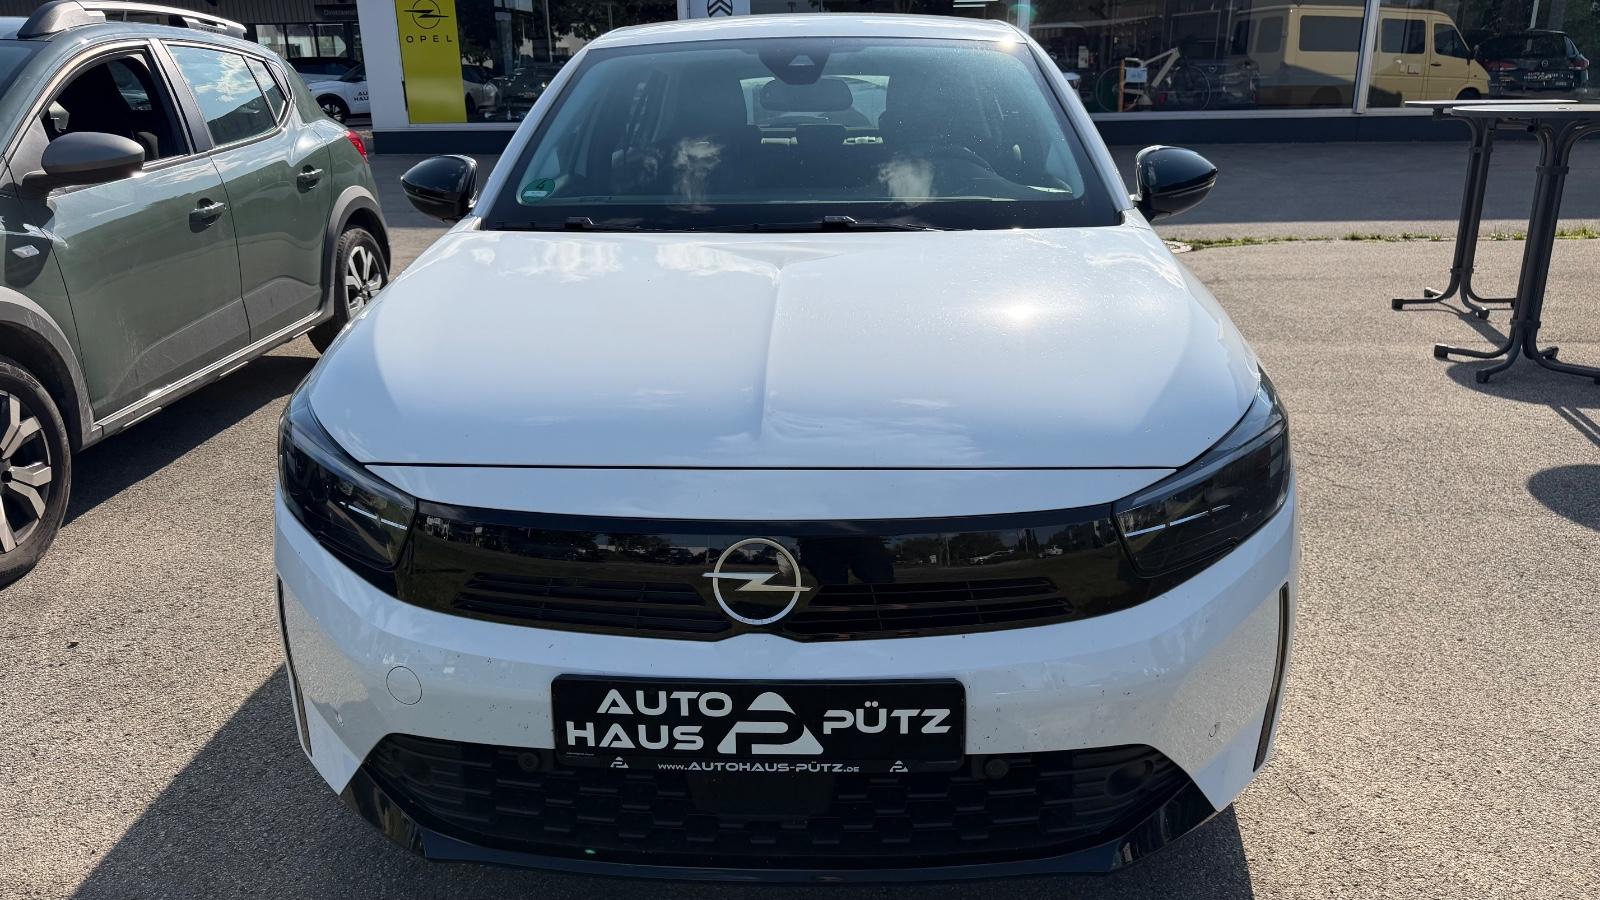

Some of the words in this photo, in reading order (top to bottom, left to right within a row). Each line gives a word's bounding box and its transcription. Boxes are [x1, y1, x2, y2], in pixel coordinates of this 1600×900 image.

[406, 34, 453, 44] OPEL
[597, 688, 733, 718] AUTO
[823, 700, 952, 735] PÜTZ
[566, 720, 705, 751] HAUS
